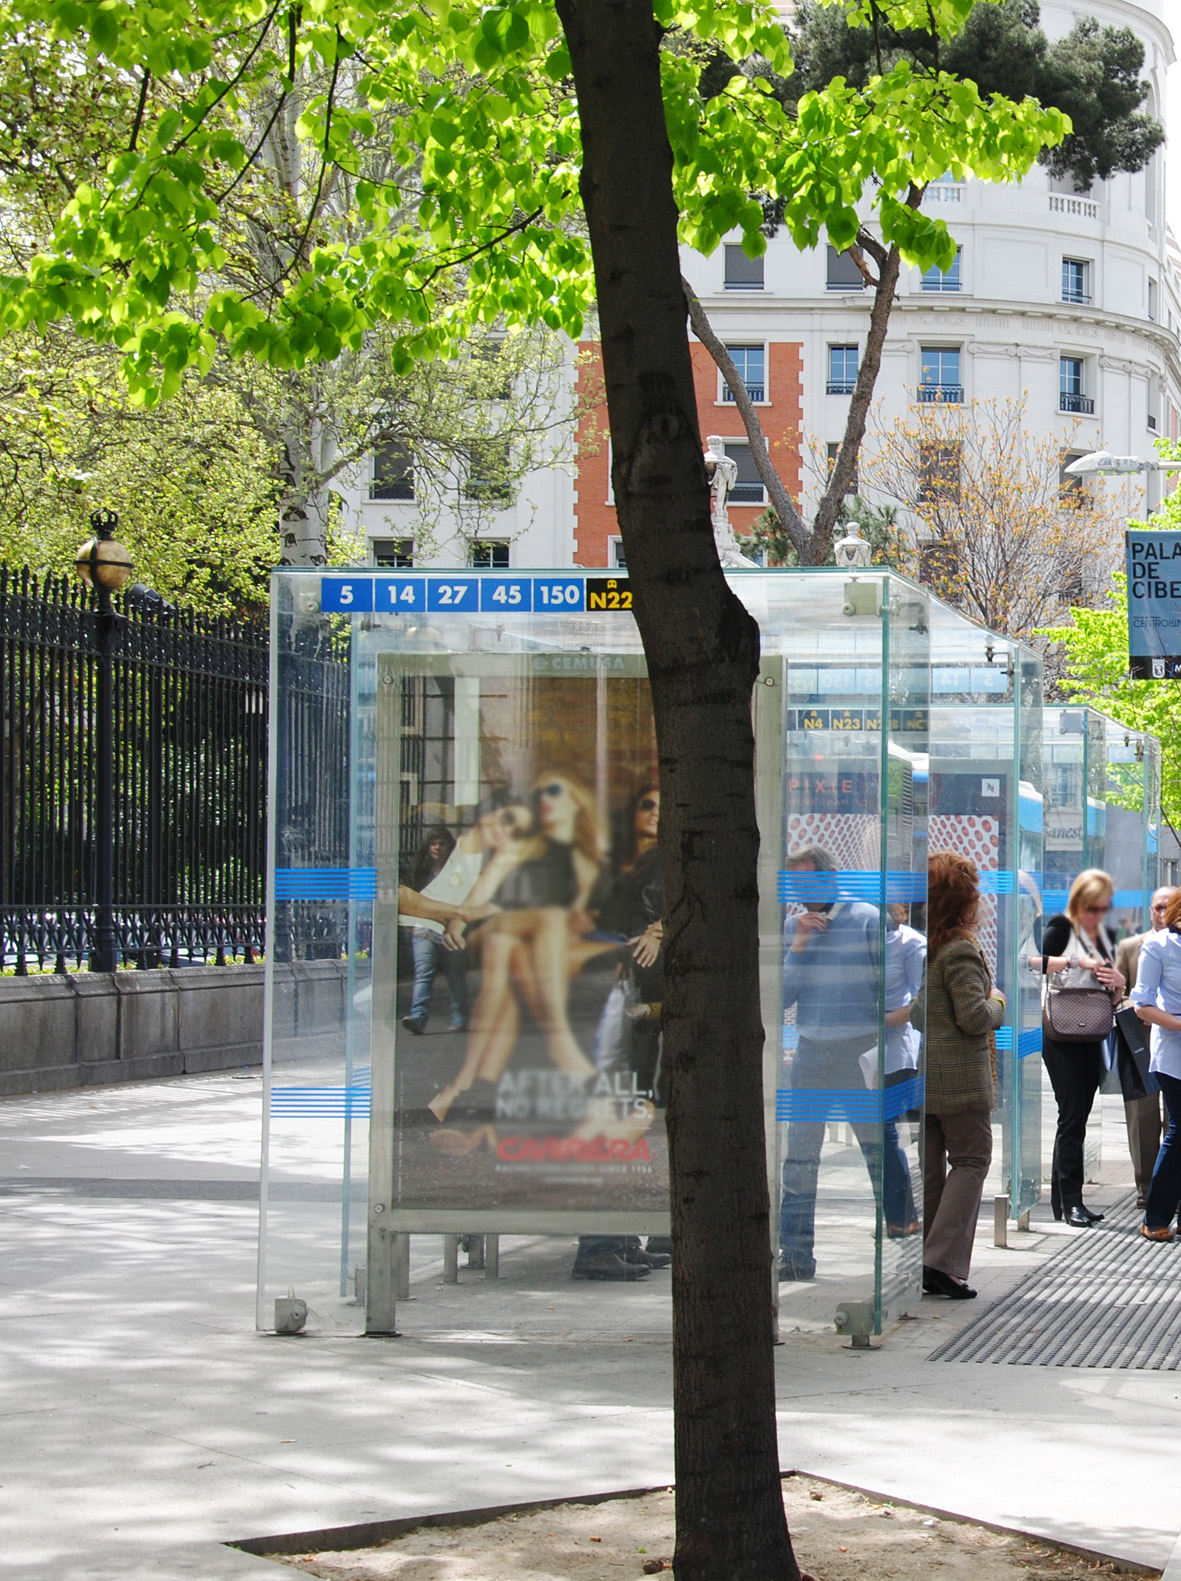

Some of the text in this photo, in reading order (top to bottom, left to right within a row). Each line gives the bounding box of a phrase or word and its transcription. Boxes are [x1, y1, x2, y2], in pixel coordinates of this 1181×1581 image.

[1132, 561, 1160, 580] DE
[339, 585, 354, 605] 5
[387, 585, 416, 604] 14
[437, 585, 469, 604] 27
[492, 585, 522, 604] 45
[540, 584, 580, 604] 150
[590, 591, 633, 609] N22
[552, 656, 625, 670] CEMUSA
[803, 718, 824, 730] N4
[832, 718, 860, 730] N23
[787, 778, 853, 794] PIXIE
[594, 1071, 654, 1098] ALL,
[631, 1165, 653, 1173] 1956
